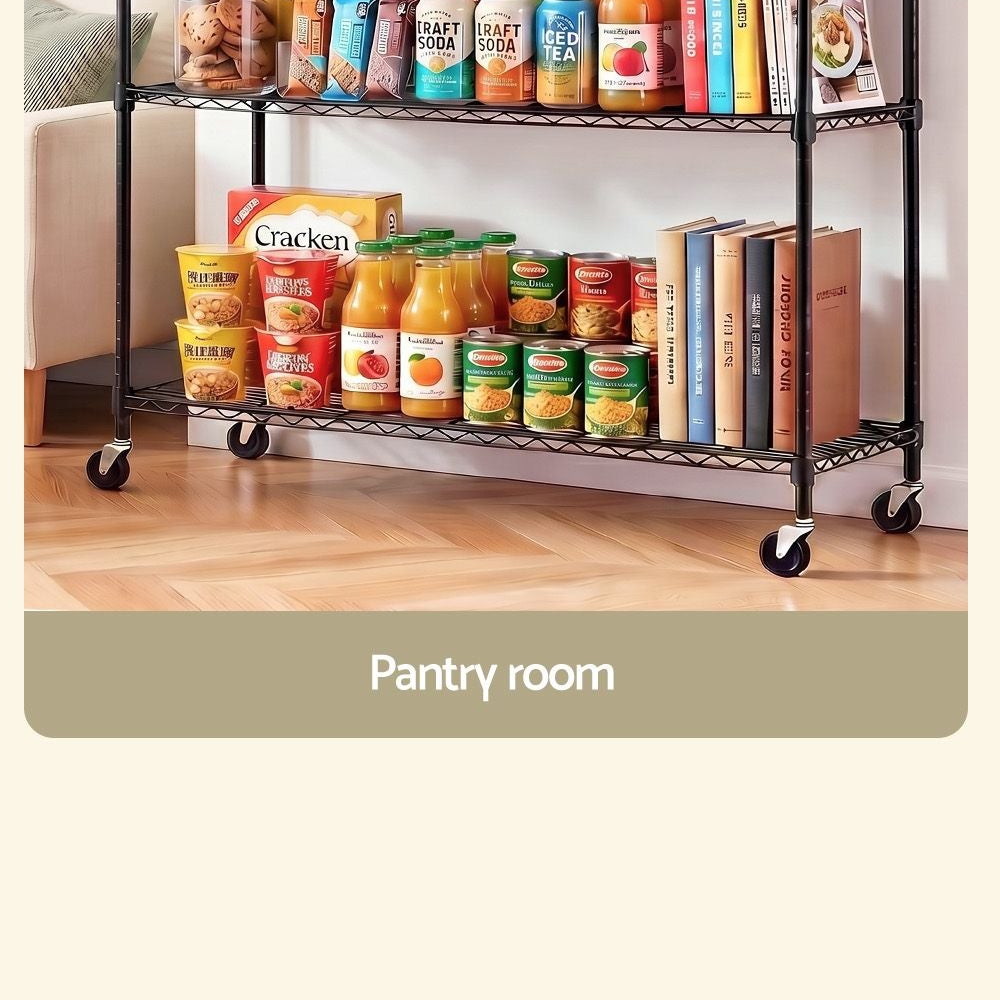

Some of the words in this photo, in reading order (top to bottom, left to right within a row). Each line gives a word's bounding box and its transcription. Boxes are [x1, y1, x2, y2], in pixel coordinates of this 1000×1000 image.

[418, 36, 456, 51] SODA
[478, 38, 516, 53] SODA
[542, 28, 579, 46] ICED
[543, 44, 576, 61] TEA
[255, 225, 350, 250] Cracken
